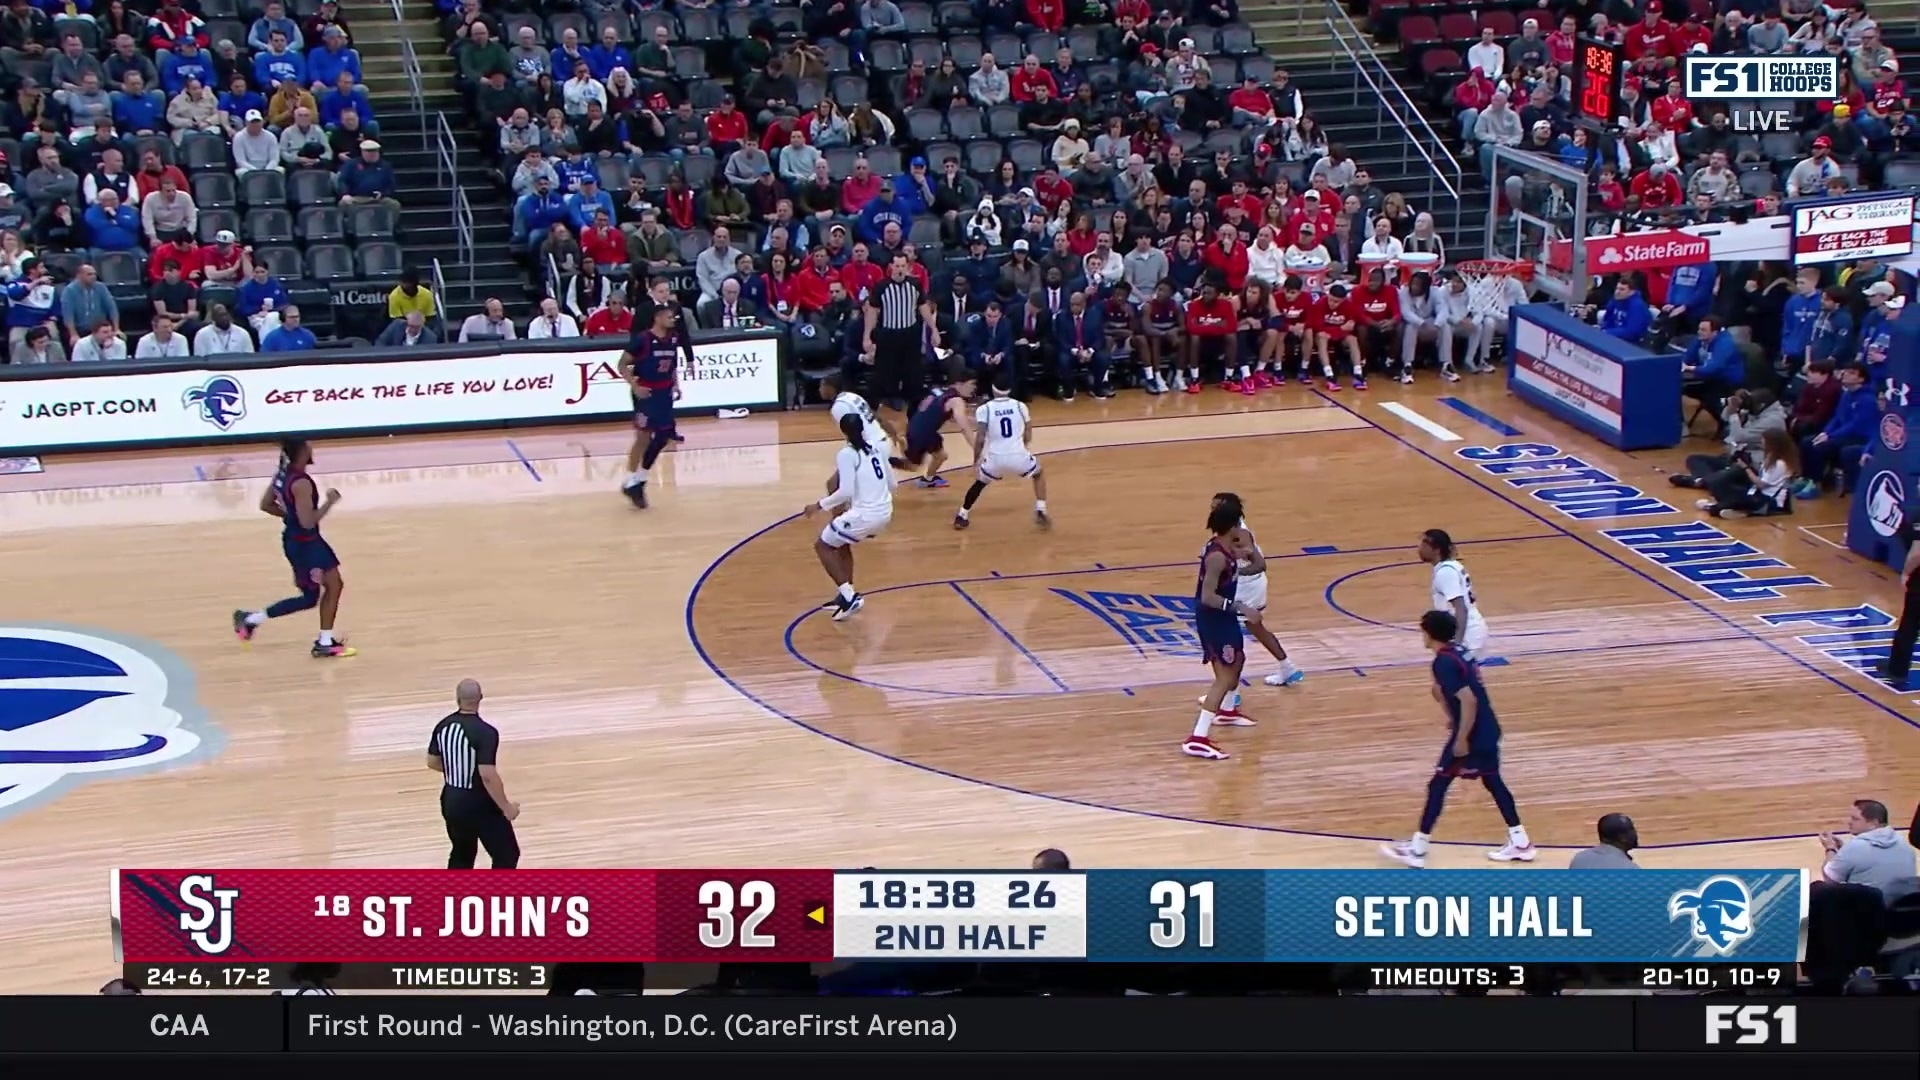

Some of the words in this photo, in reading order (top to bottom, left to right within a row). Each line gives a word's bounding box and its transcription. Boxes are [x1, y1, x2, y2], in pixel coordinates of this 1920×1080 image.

[1584, 71, 1609, 117] 26
[1800, 207, 1854, 234] JAG
[1817, 242, 1839, 251] LIFE
[1841, 240, 1860, 249] YOU
[1818, 234, 1839, 243] GET
[1841, 231, 1868, 241] BACK
[1869, 228, 1889, 238] THE
[265, 388, 307, 404] GET
[313, 386, 365, 402] BACK
[372, 384, 407, 399] THE
[415, 380, 455, 396] LIFE
[462, 379, 496, 393] YOU
[503, 374, 554, 391] LOVE!
[565, 362, 624, 404] JA
[22, 398, 156, 419] JAGPT.COM
[1000, 416, 1013, 438] 0
[871, 457, 884, 480] 6
[1454, 442, 1682, 520] SETON
[1597, 520, 1832, 602] HALL
